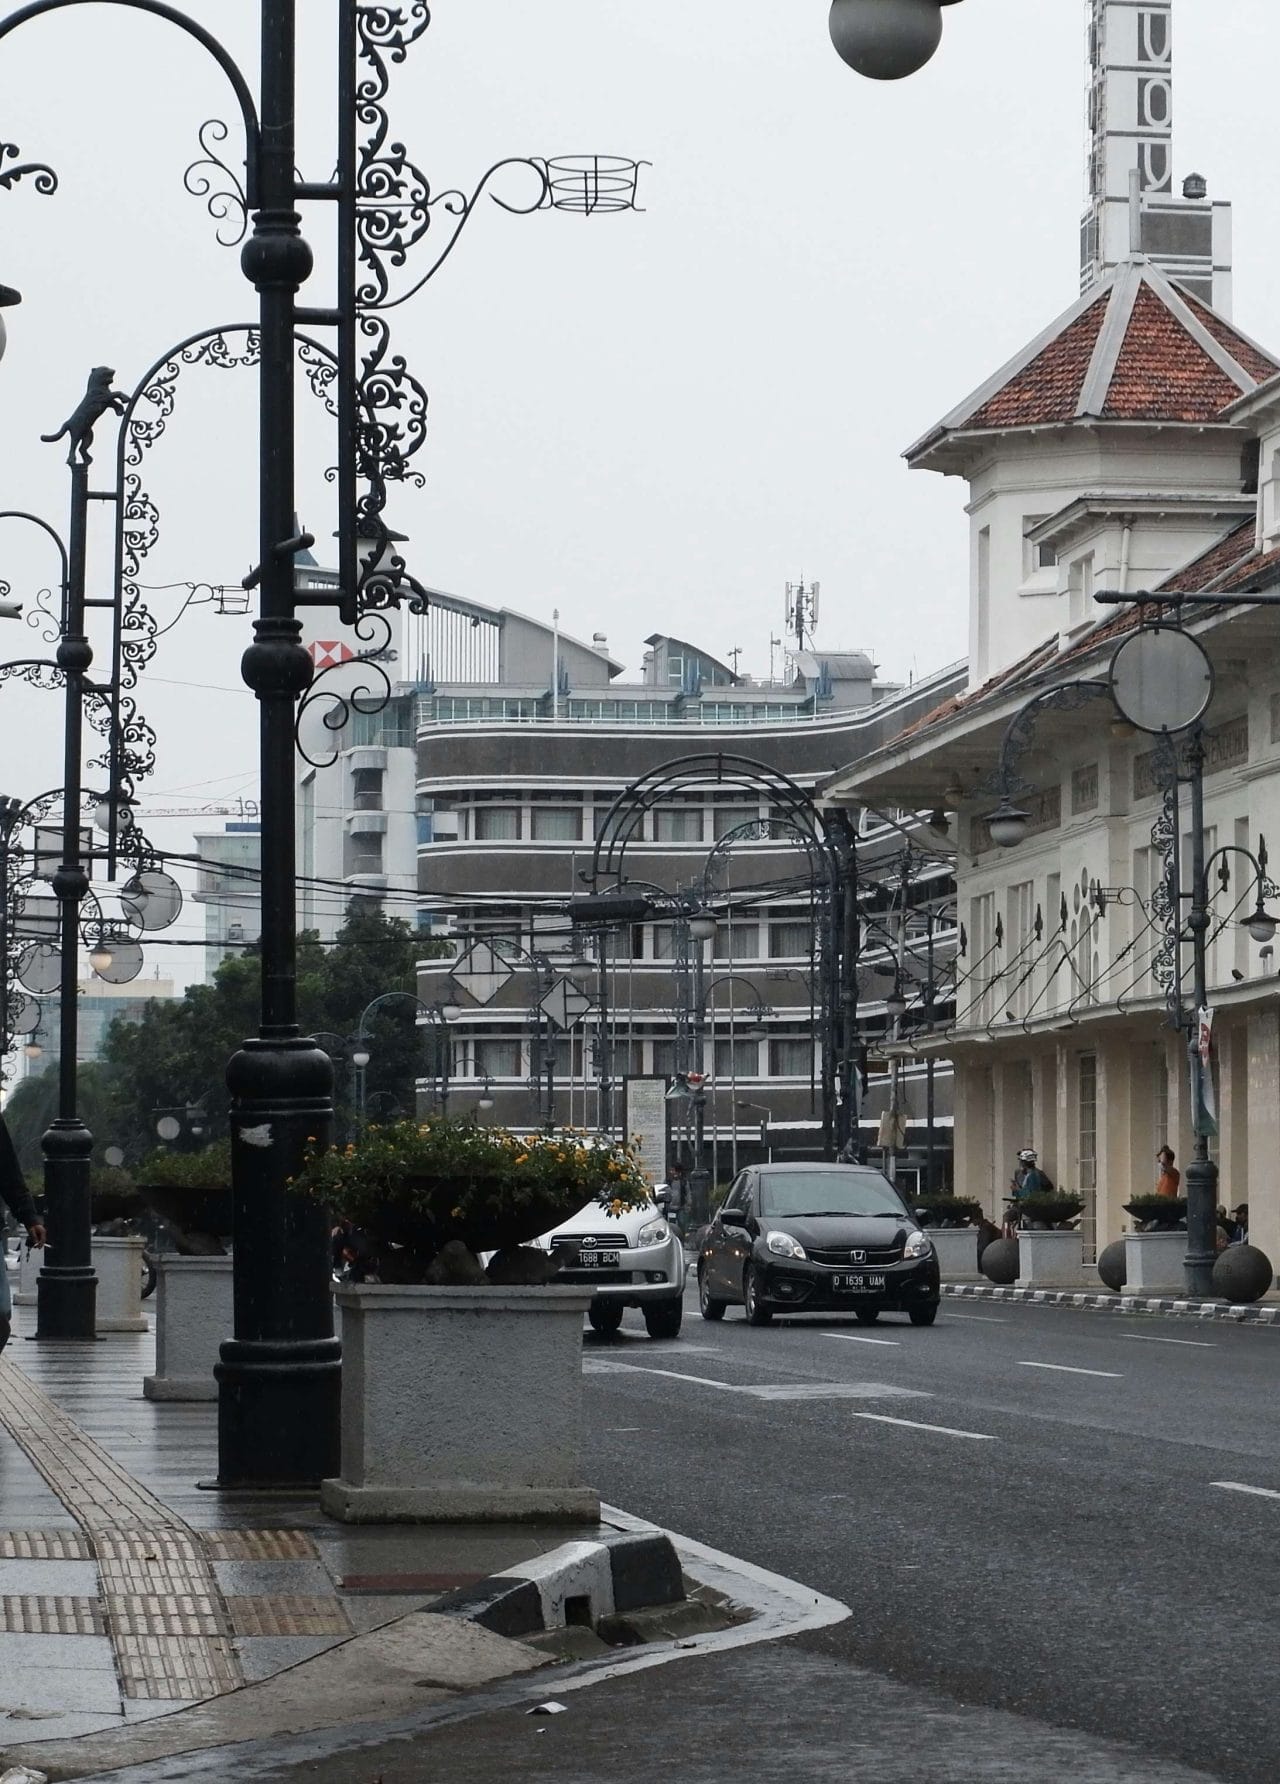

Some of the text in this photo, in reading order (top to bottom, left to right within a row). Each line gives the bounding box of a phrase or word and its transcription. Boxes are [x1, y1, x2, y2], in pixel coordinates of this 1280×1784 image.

[579, 1252, 620, 1263] 1688 BCM
[834, 1275, 885, 1286] D 1639 UAM
